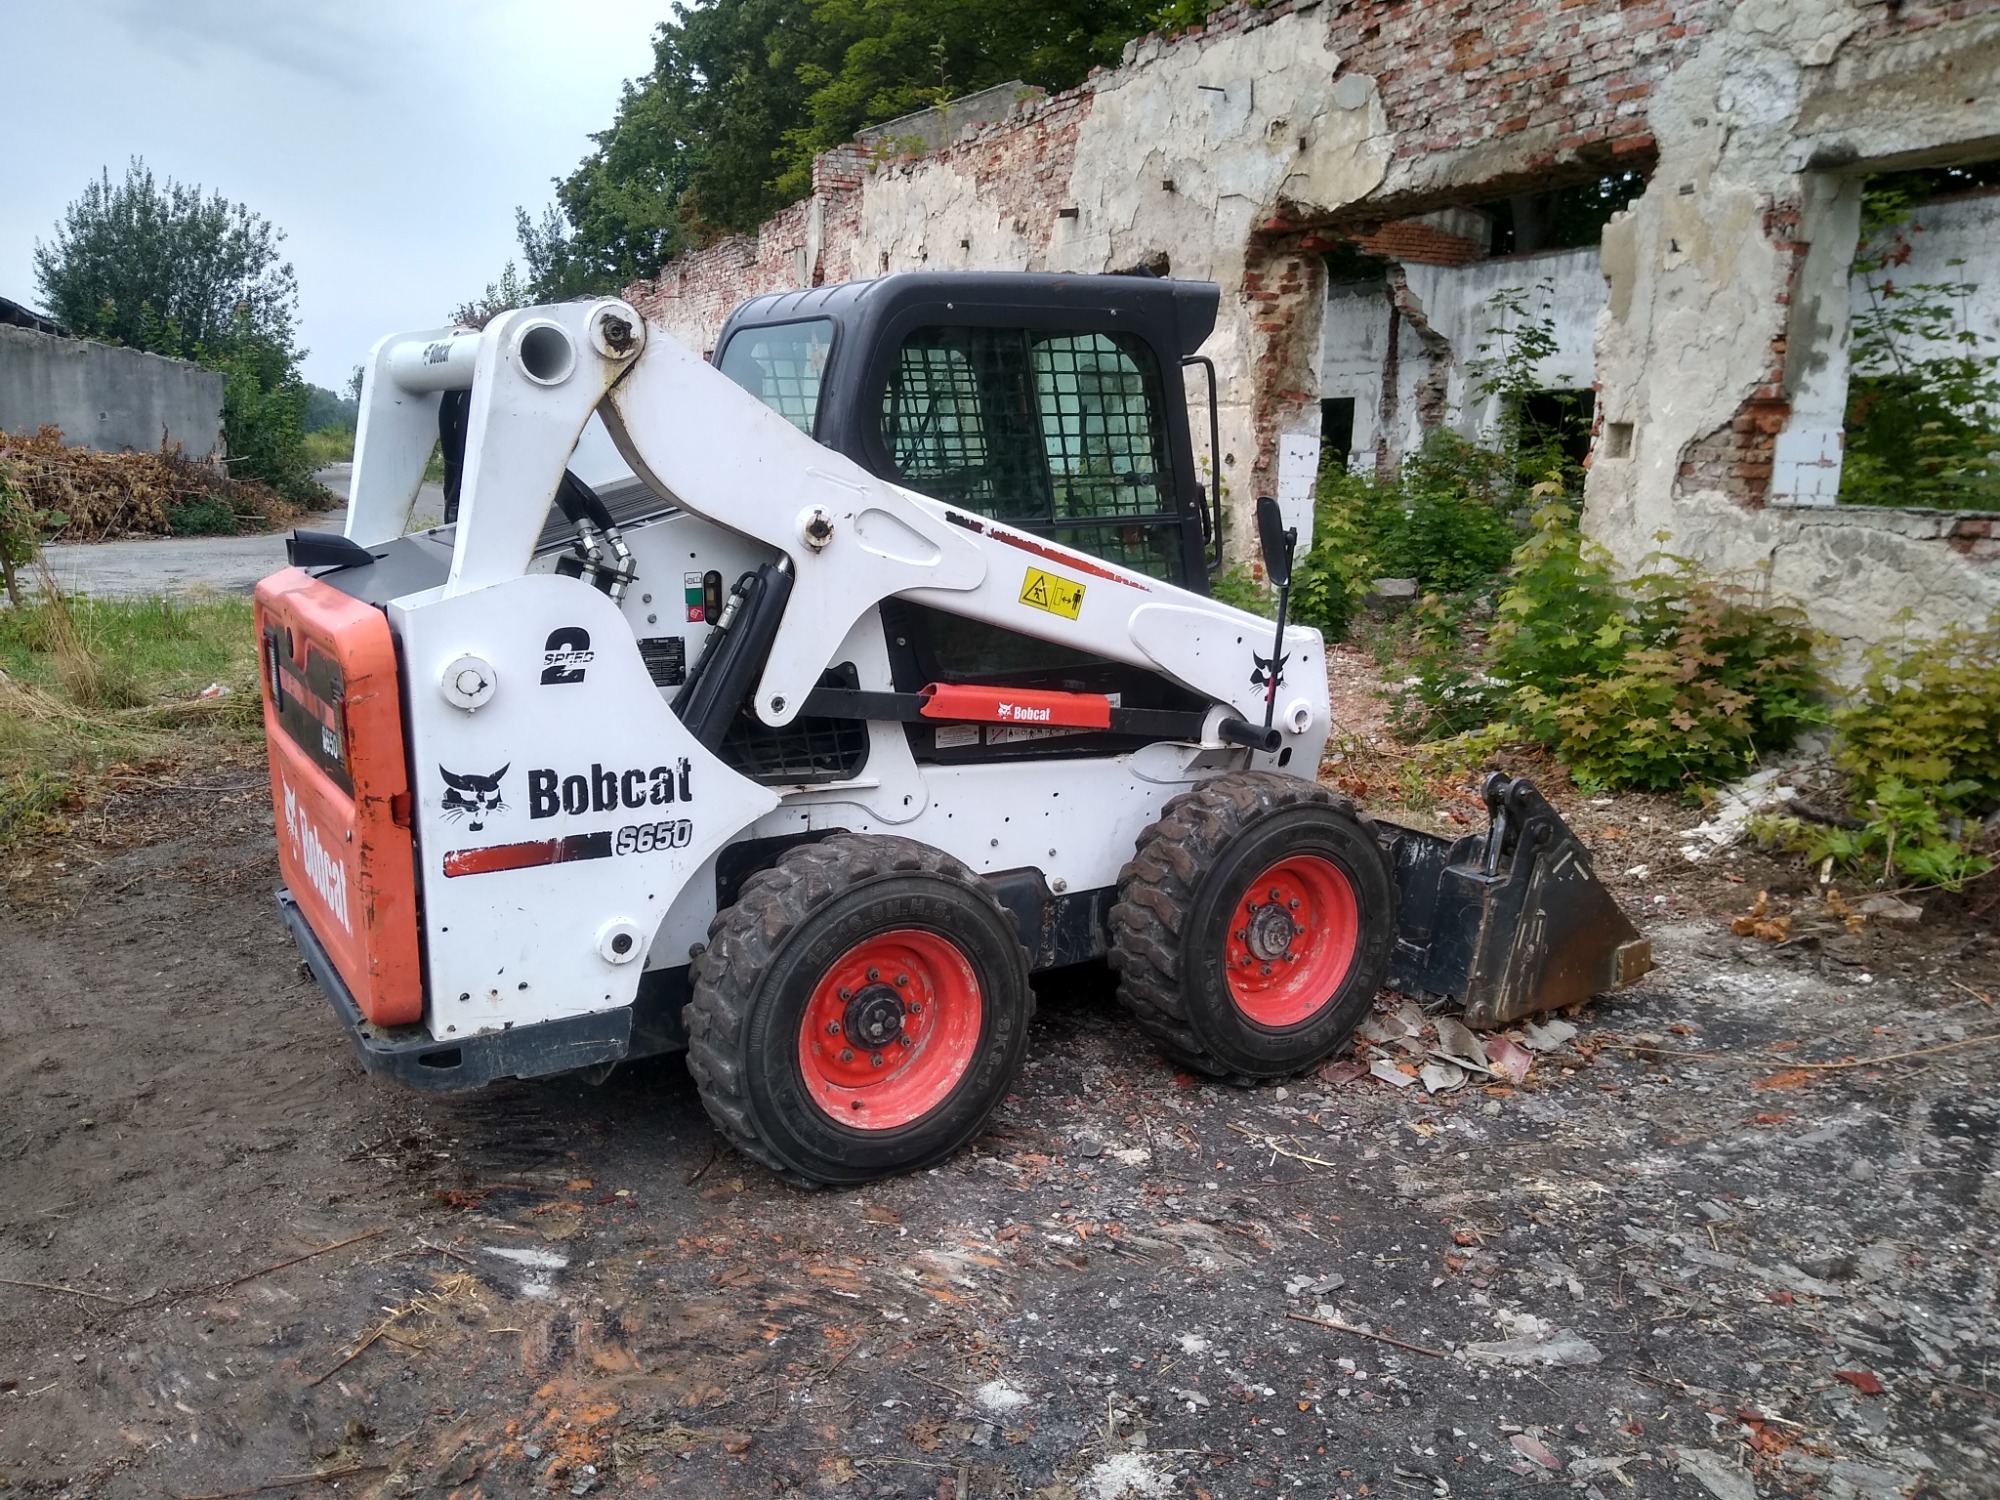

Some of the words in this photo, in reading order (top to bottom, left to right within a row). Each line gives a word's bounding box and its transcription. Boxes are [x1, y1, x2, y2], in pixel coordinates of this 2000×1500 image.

[540, 626, 591, 685] 2
[1013, 706, 1051, 721] Bobcat
[528, 757, 693, 819] Bobcat
[616, 819, 693, 856] S650
[299, 805, 351, 935] Bobcat
